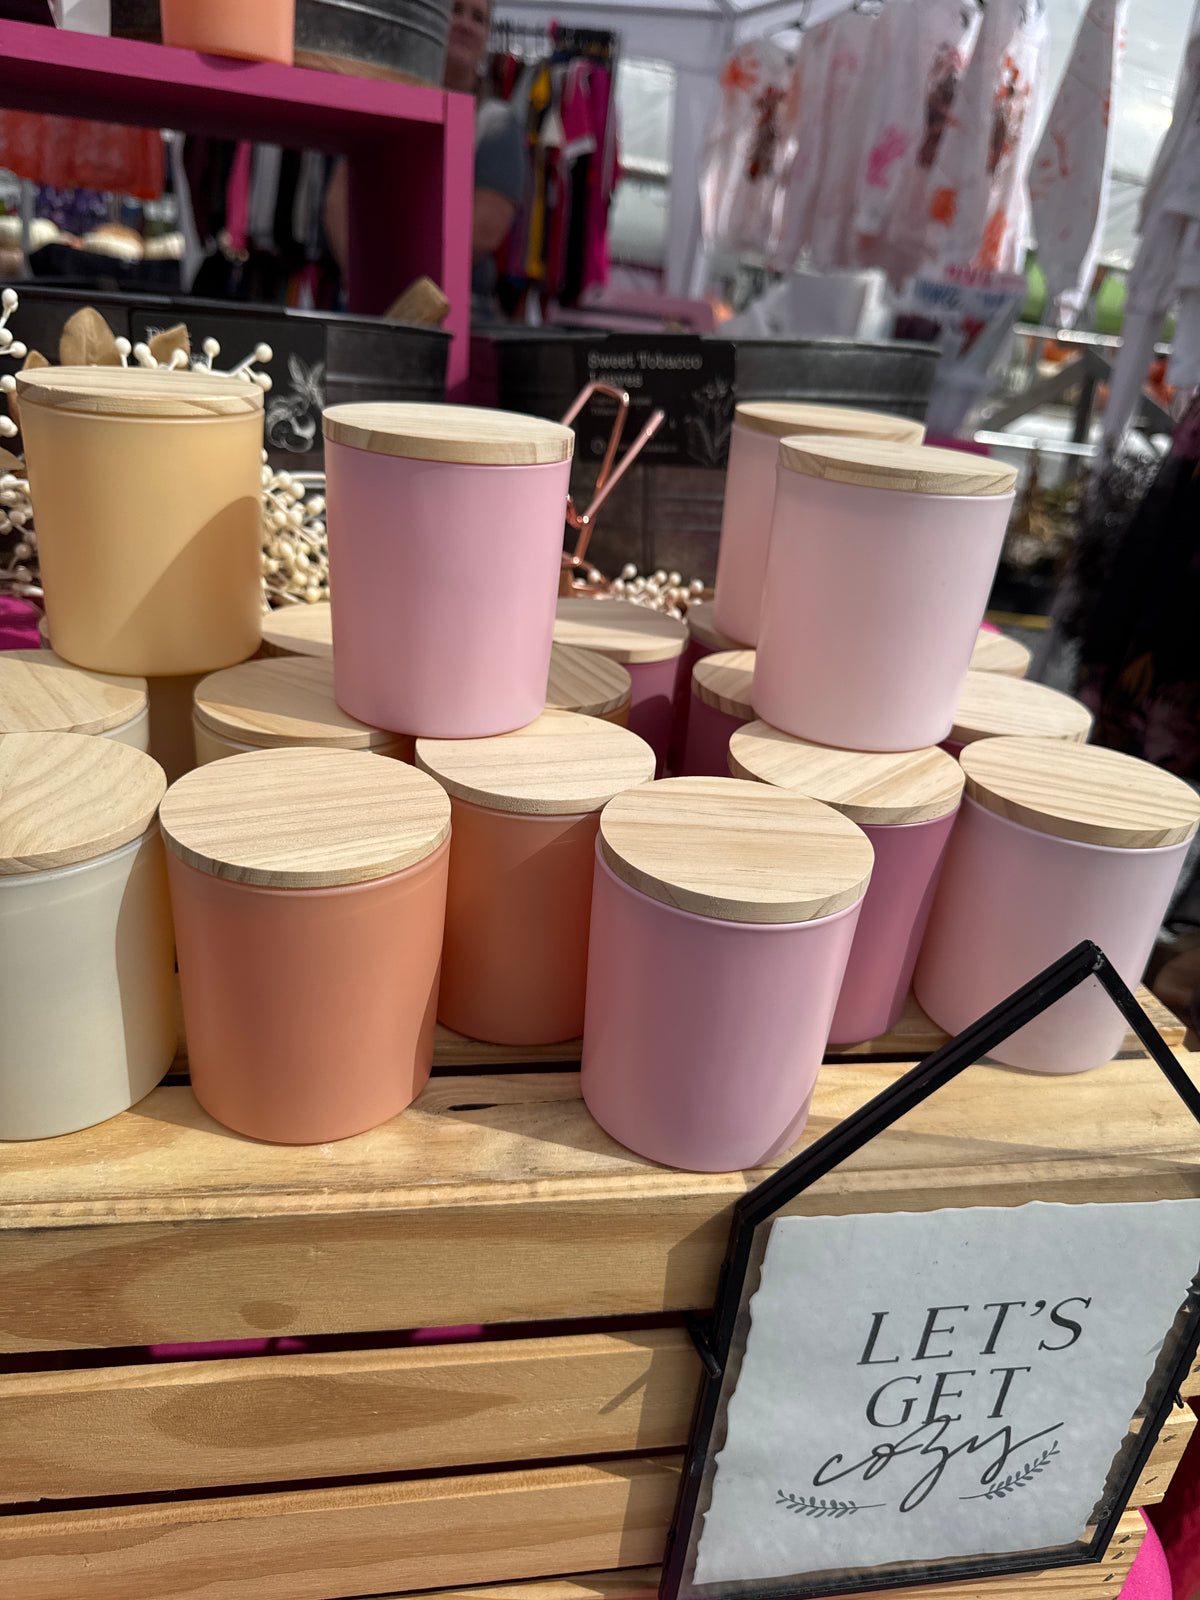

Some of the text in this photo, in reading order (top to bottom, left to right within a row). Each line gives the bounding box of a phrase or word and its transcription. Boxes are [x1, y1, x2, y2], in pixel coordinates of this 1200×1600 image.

[588, 350, 702, 370] Sweet Tobacco
[857, 1297, 1092, 1366] LET'S
[865, 1366, 1032, 1428] GET
[812, 1414, 1065, 1513] cozy
